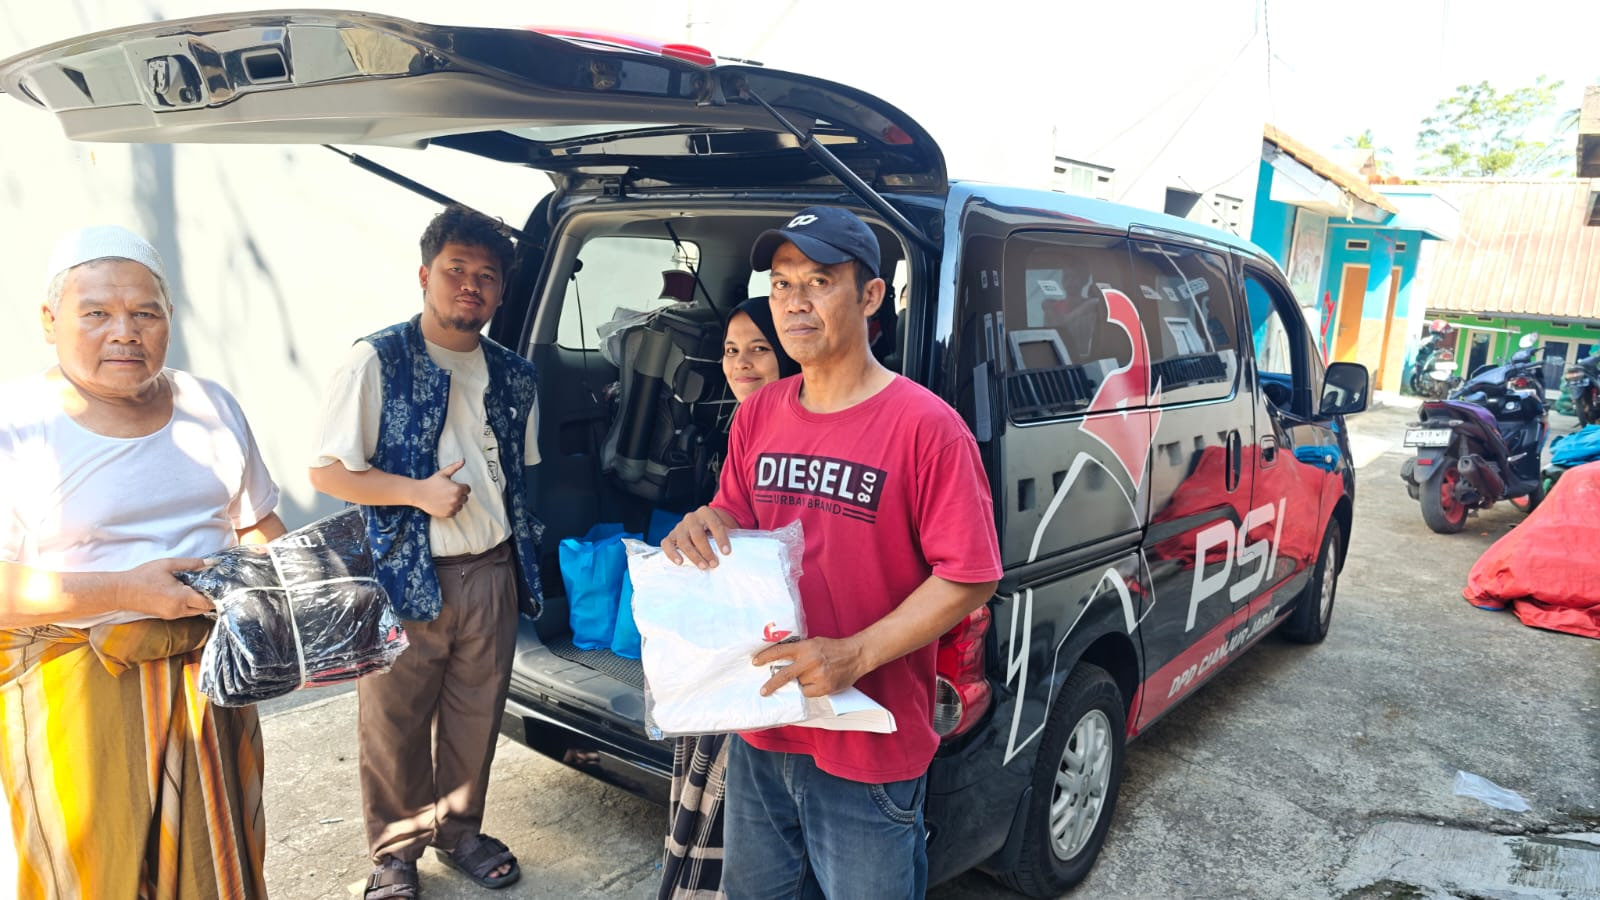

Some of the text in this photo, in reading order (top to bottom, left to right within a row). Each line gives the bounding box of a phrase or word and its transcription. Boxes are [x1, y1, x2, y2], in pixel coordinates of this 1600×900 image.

[757, 457, 854, 500] DIESEL
[857, 471, 877, 503] 078
[808, 498, 842, 515] BRAND
[1185, 498, 1287, 632] PSI
[1168, 664, 1198, 698] DPD
